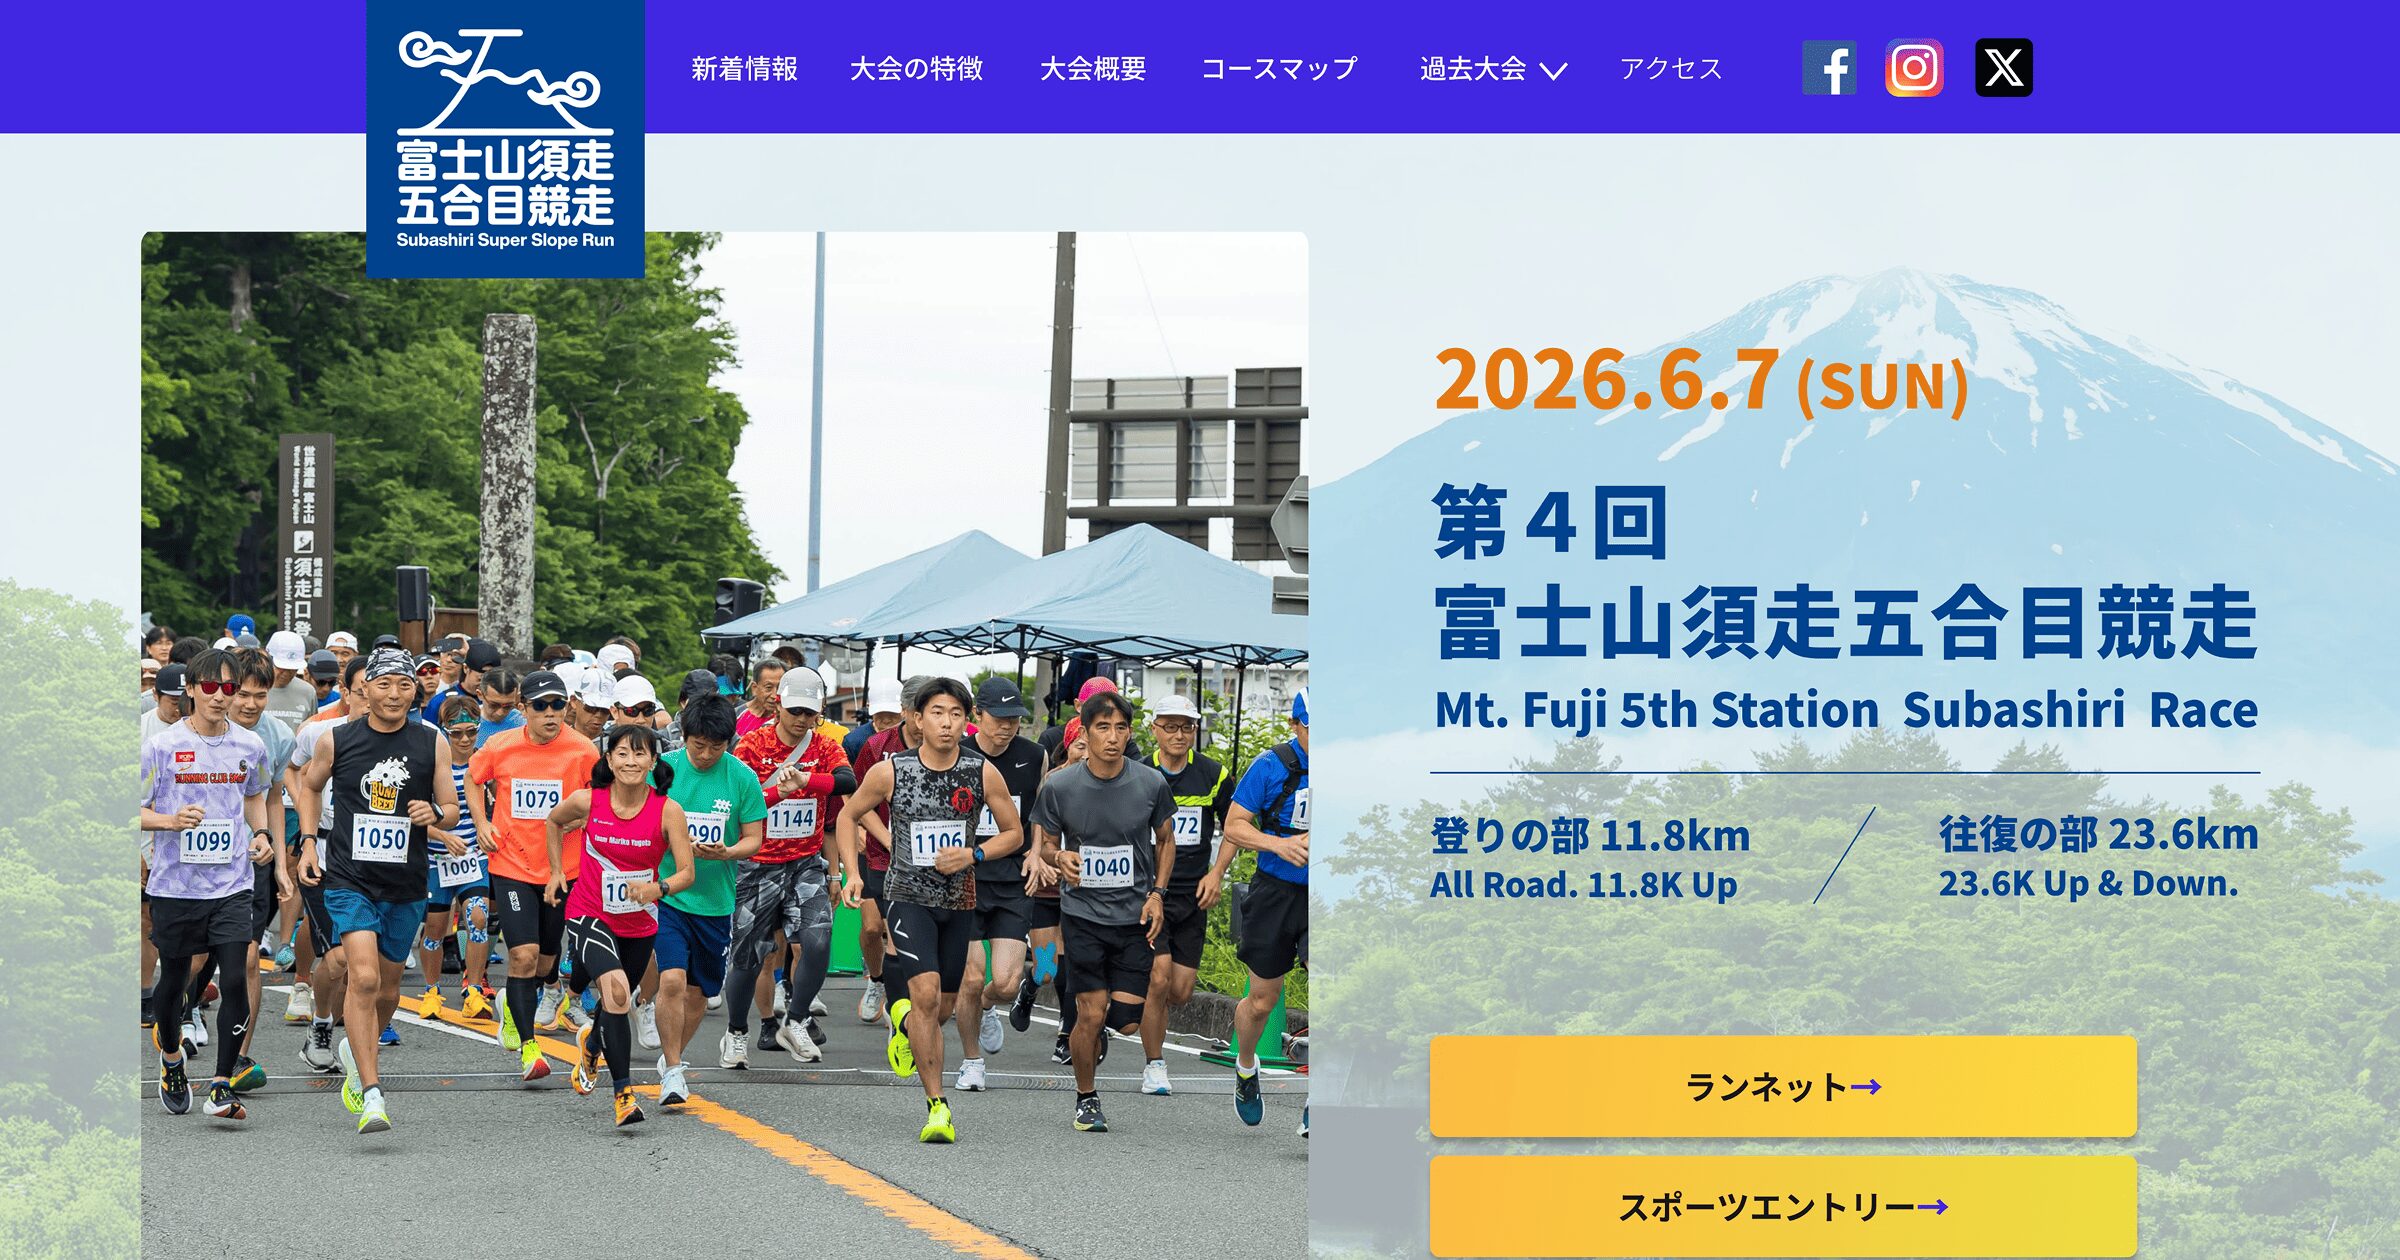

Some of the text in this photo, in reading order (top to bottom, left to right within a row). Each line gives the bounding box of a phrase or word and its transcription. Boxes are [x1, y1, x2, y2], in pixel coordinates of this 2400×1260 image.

[515, 790, 560, 808] 1079
[771, 809, 814, 828] 1144
[185, 831, 231, 852] 1099
[358, 827, 406, 850] 1050
[688, 824, 721, 843] 090
[915, 832, 963, 854] 1106
[441, 857, 477, 877] 1009
[1084, 857, 1130, 877] 1040
[606, 883, 628, 902] 10
